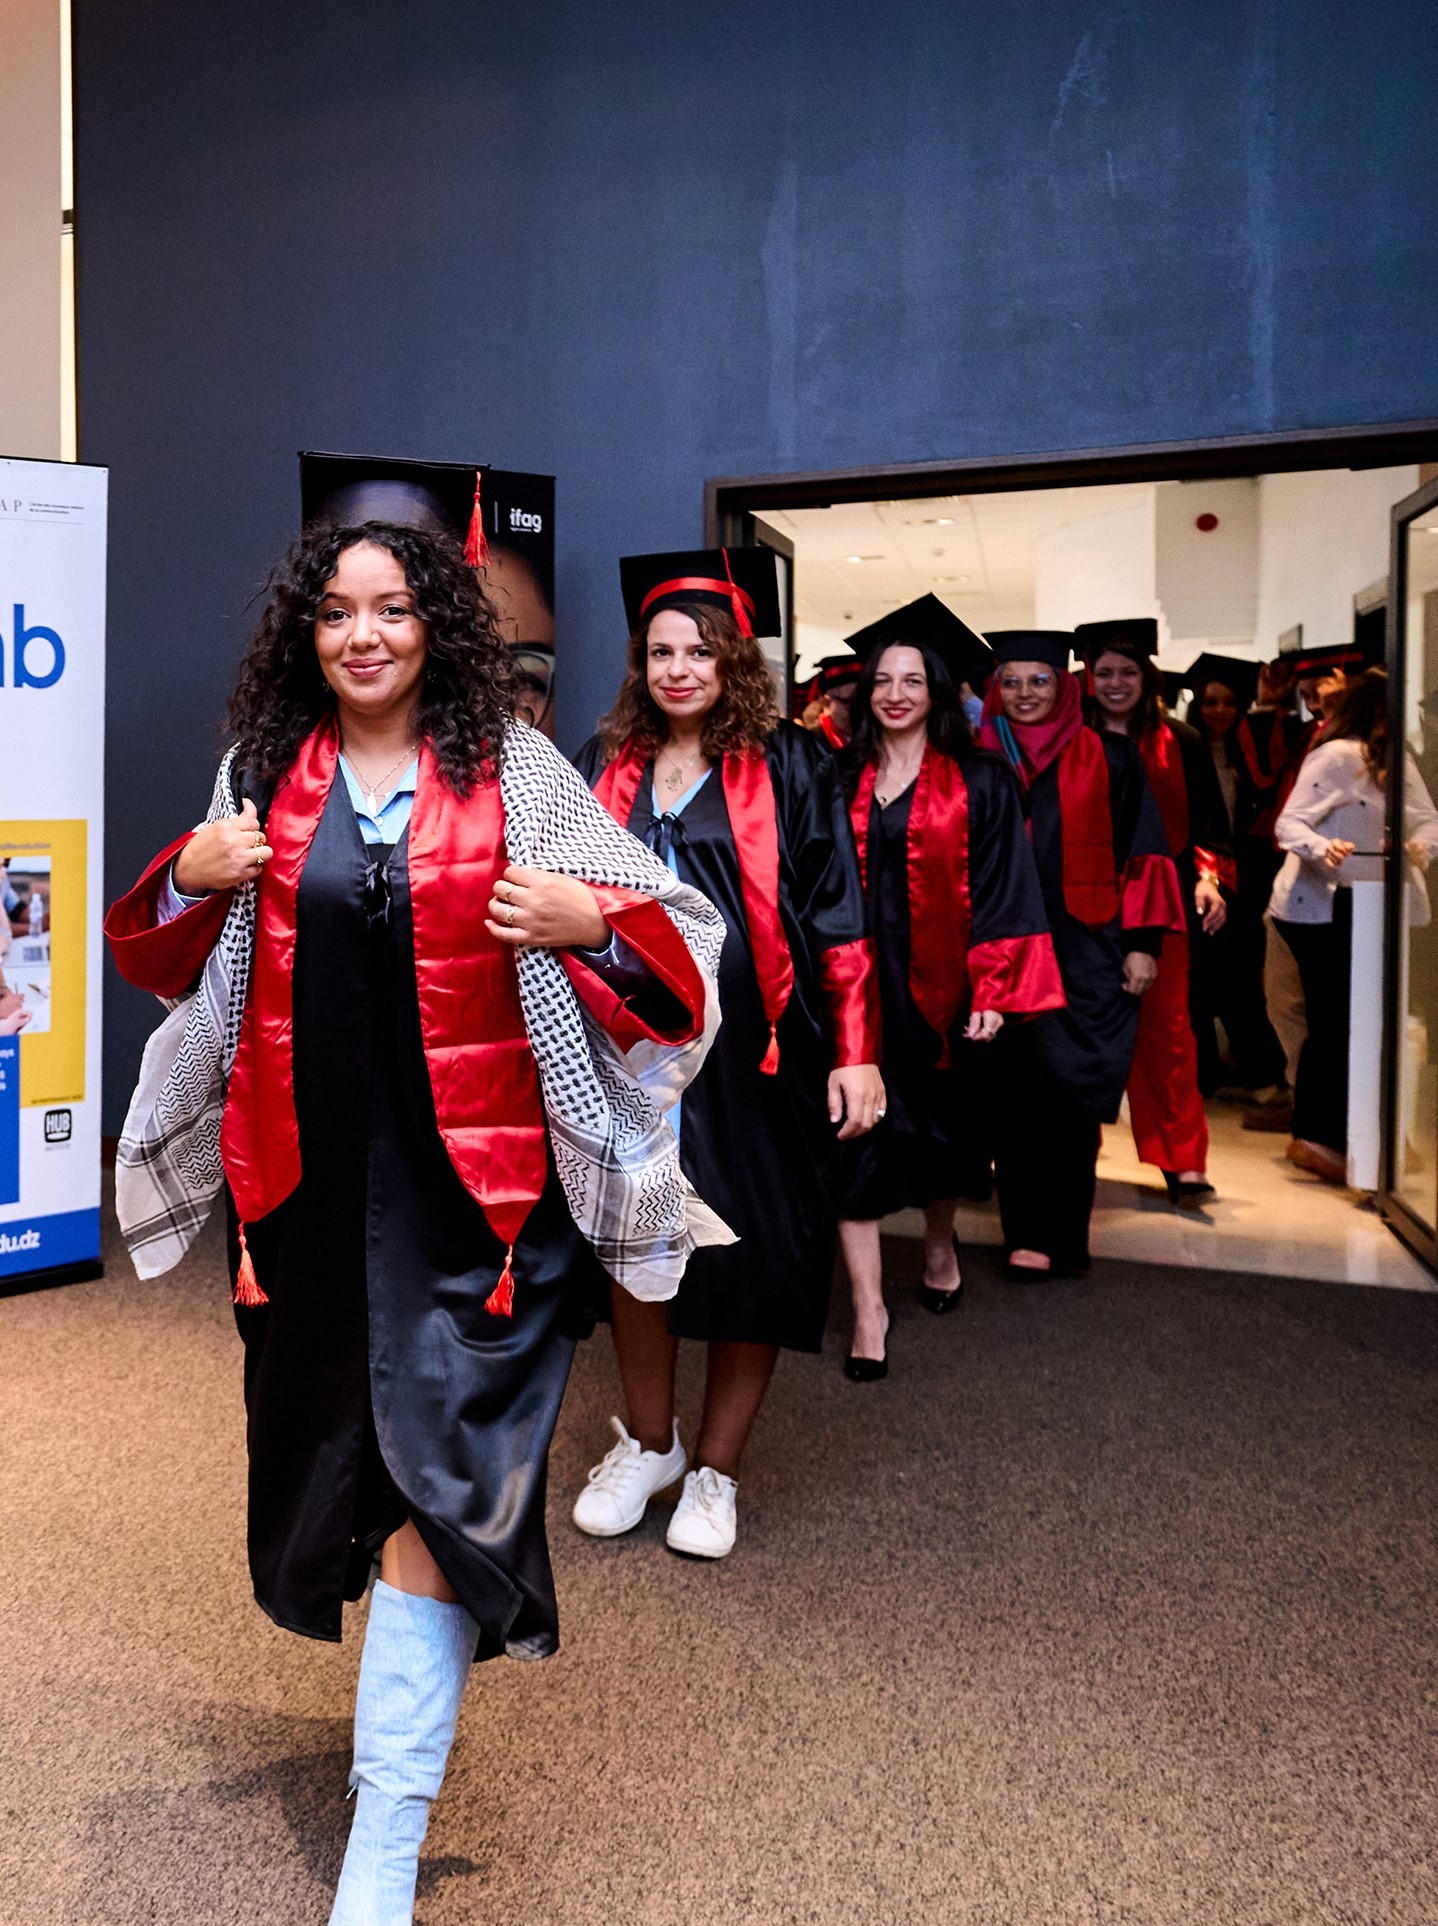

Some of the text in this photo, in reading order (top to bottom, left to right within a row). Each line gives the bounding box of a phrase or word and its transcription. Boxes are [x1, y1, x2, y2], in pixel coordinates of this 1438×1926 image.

[510, 508, 542, 533] ifag
[0, 604, 65, 689] b
[46, 1112, 70, 1134] HUB
